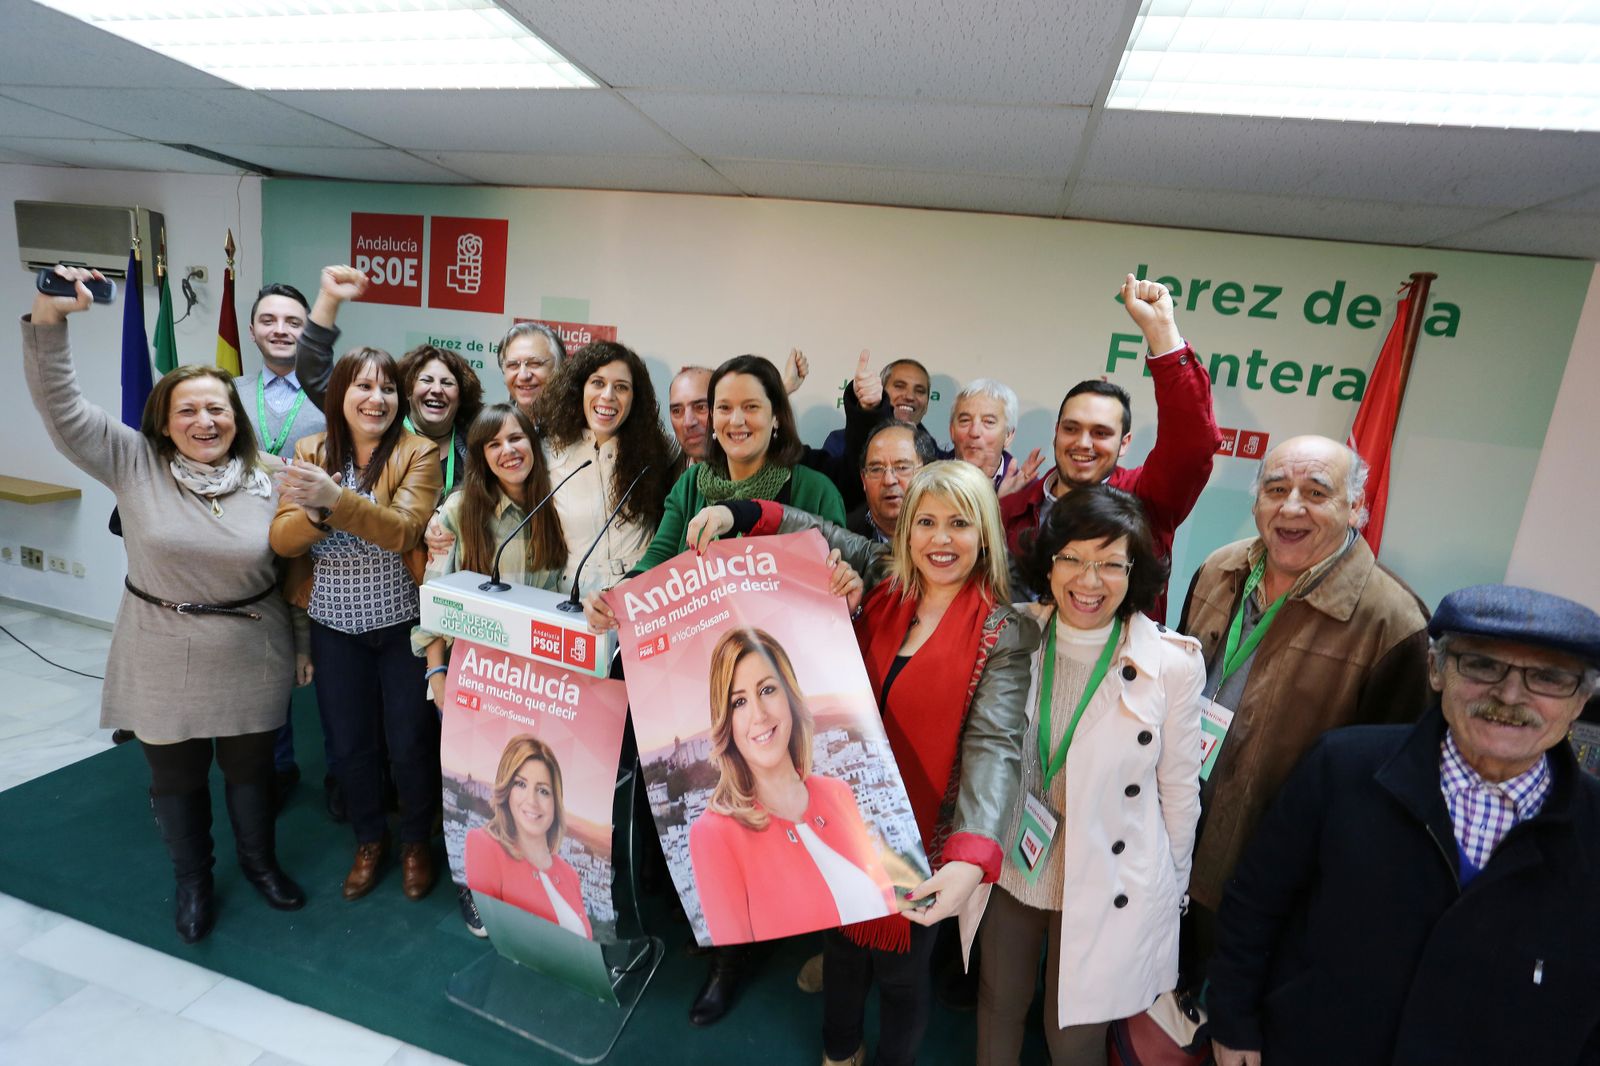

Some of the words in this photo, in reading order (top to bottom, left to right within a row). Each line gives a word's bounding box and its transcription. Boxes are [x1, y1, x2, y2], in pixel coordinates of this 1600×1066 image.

[357, 235, 418, 253] Andalucía
[355, 254, 418, 288] PSOE
[1303, 280, 1382, 329] de
[1423, 300, 1461, 338] a
[466, 340, 484, 352] de
[624, 545, 778, 622] Andalucía
[445, 607, 459, 621] LA
[461, 612, 503, 633] FUERZA
[634, 616, 667, 638] tiene
[668, 594, 708, 623] mucho
[711, 582, 738, 604] que
[740, 577, 781, 592] decir
[441, 617, 461, 632] QUE
[463, 623, 485, 639] NOS
[486, 629, 508, 645] UNE
[671, 609, 730, 643] #YoConSusana
[533, 635, 560, 655] PSOE
[460, 647, 581, 706] Andalucía
[458, 674, 485, 693] tiene
[486, 683, 523, 704] mucho
[525, 695, 546, 711] que
[548, 700, 578, 721] decir
[482, 703, 535, 726] #YoConSusana
